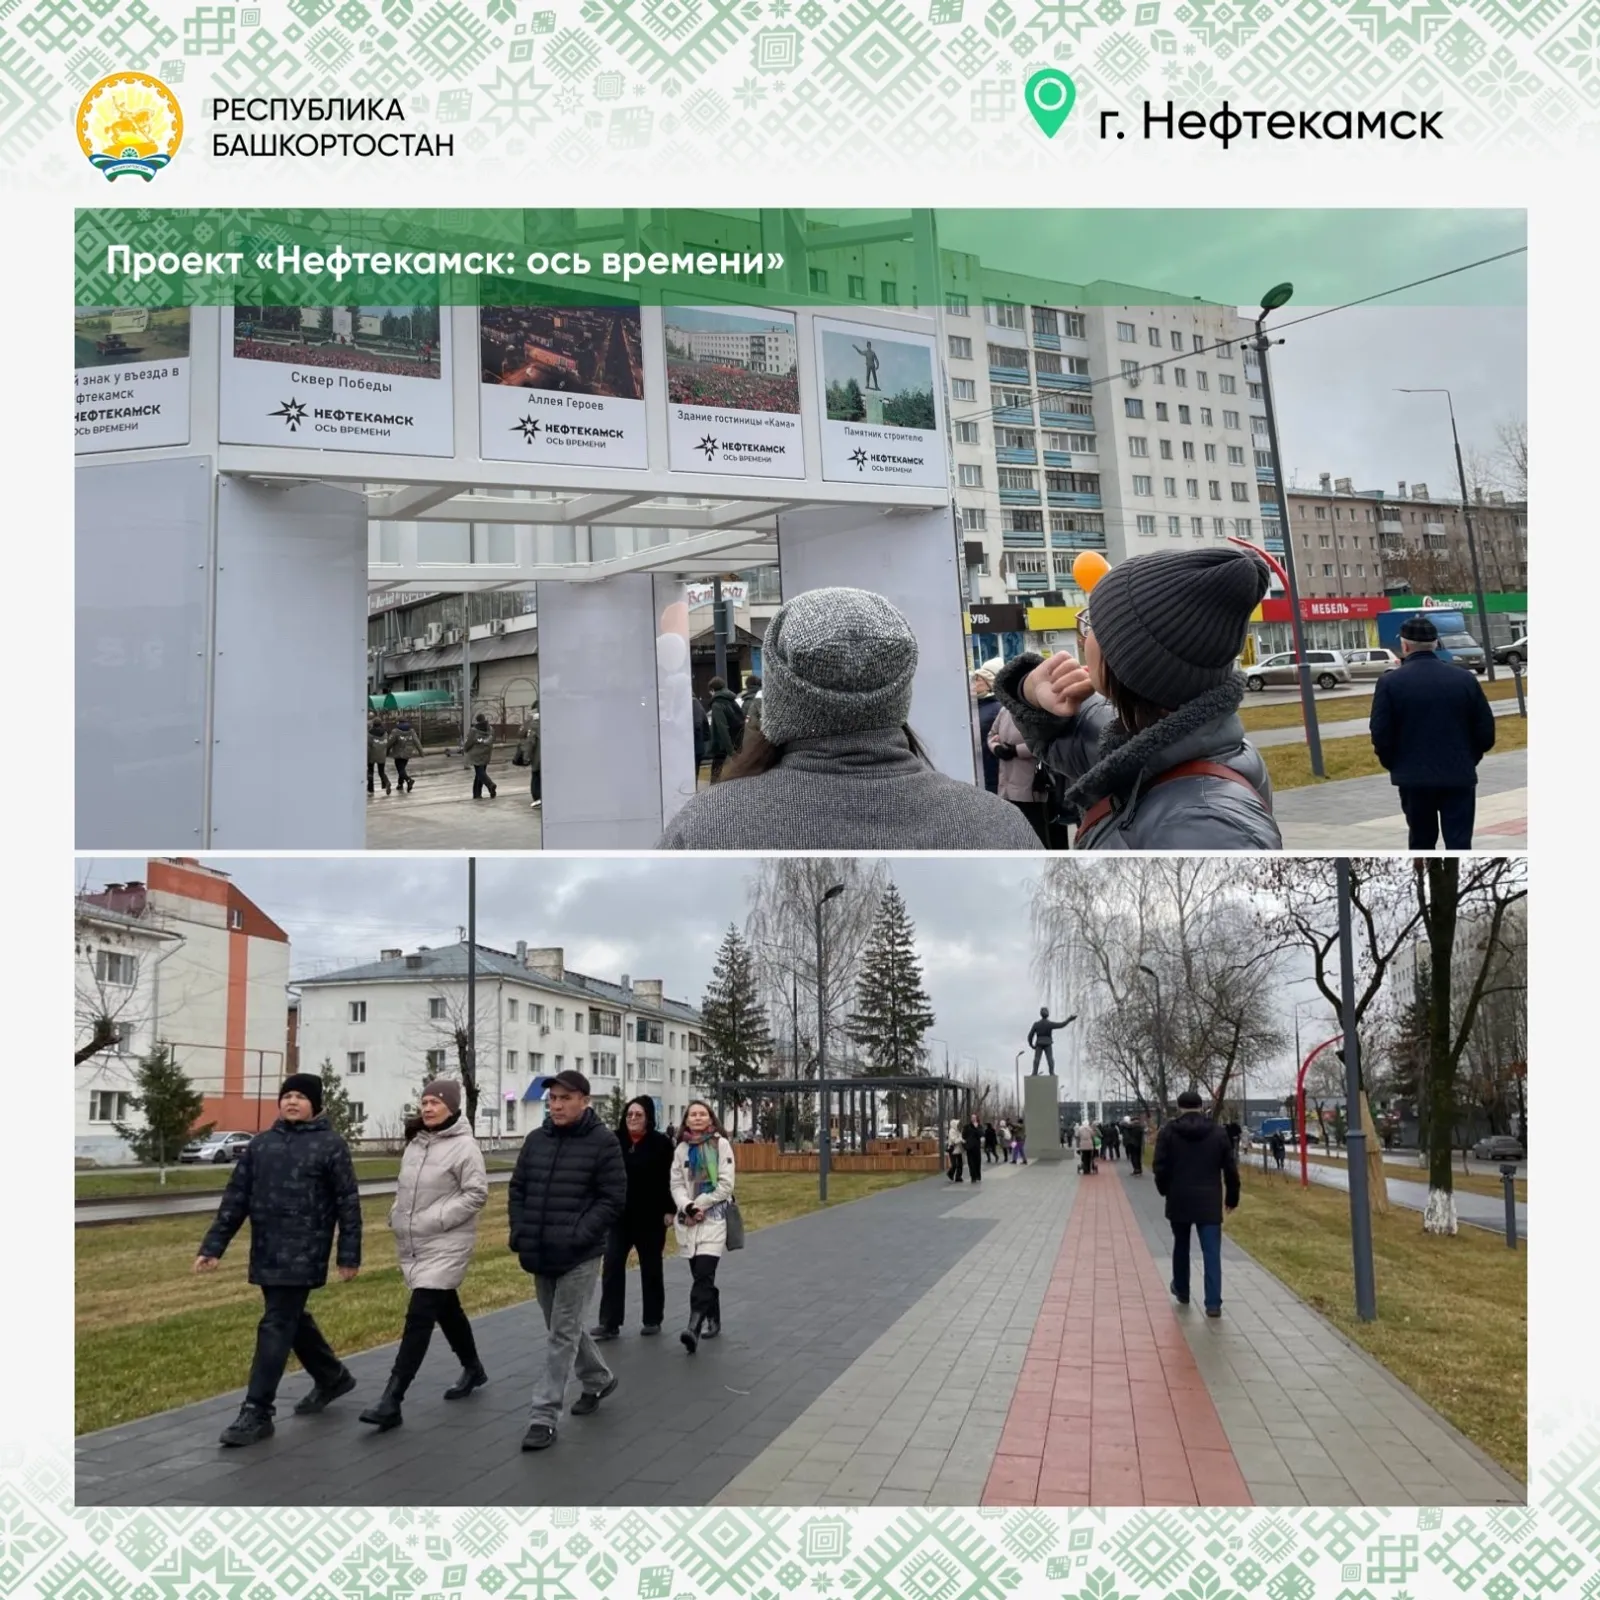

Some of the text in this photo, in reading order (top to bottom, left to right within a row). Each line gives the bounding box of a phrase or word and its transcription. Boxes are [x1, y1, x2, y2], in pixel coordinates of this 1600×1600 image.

[83, 375, 110, 386] знак
[114, 374, 121, 385] у
[124, 368, 168, 382] въезда
[172, 367, 179, 377] в
[291, 371, 391, 392] Сквер Победы
[76, 389, 134, 405] фтекамск
[528, 393, 604, 411] Аллея Героев
[314, 408, 414, 426] НЕФТЕКАМСК
[678, 410, 795, 428] Здание гостиницы «Кама»
[93, 422, 138, 434] ВРЕМЕНИ
[315, 424, 391, 437] ОСЬ ВРЕМЕНИ
[545, 424, 624, 439] НЕФТЕКАМСК
[844, 426, 924, 442] Памятник строителю
[546, 437, 606, 448] ОСЬ ВРЕМЕНИ
[722, 442, 785, 454] НЕФТЕКАМСК
[723, 454, 772, 463] ОСЬ ВРЕМЕНИ
[870, 453, 925, 465] НЕФТЕКАМСК
[1311, 603, 1349, 614] МЕБЕЛЬ
[970, 613, 991, 624] УВЬ
